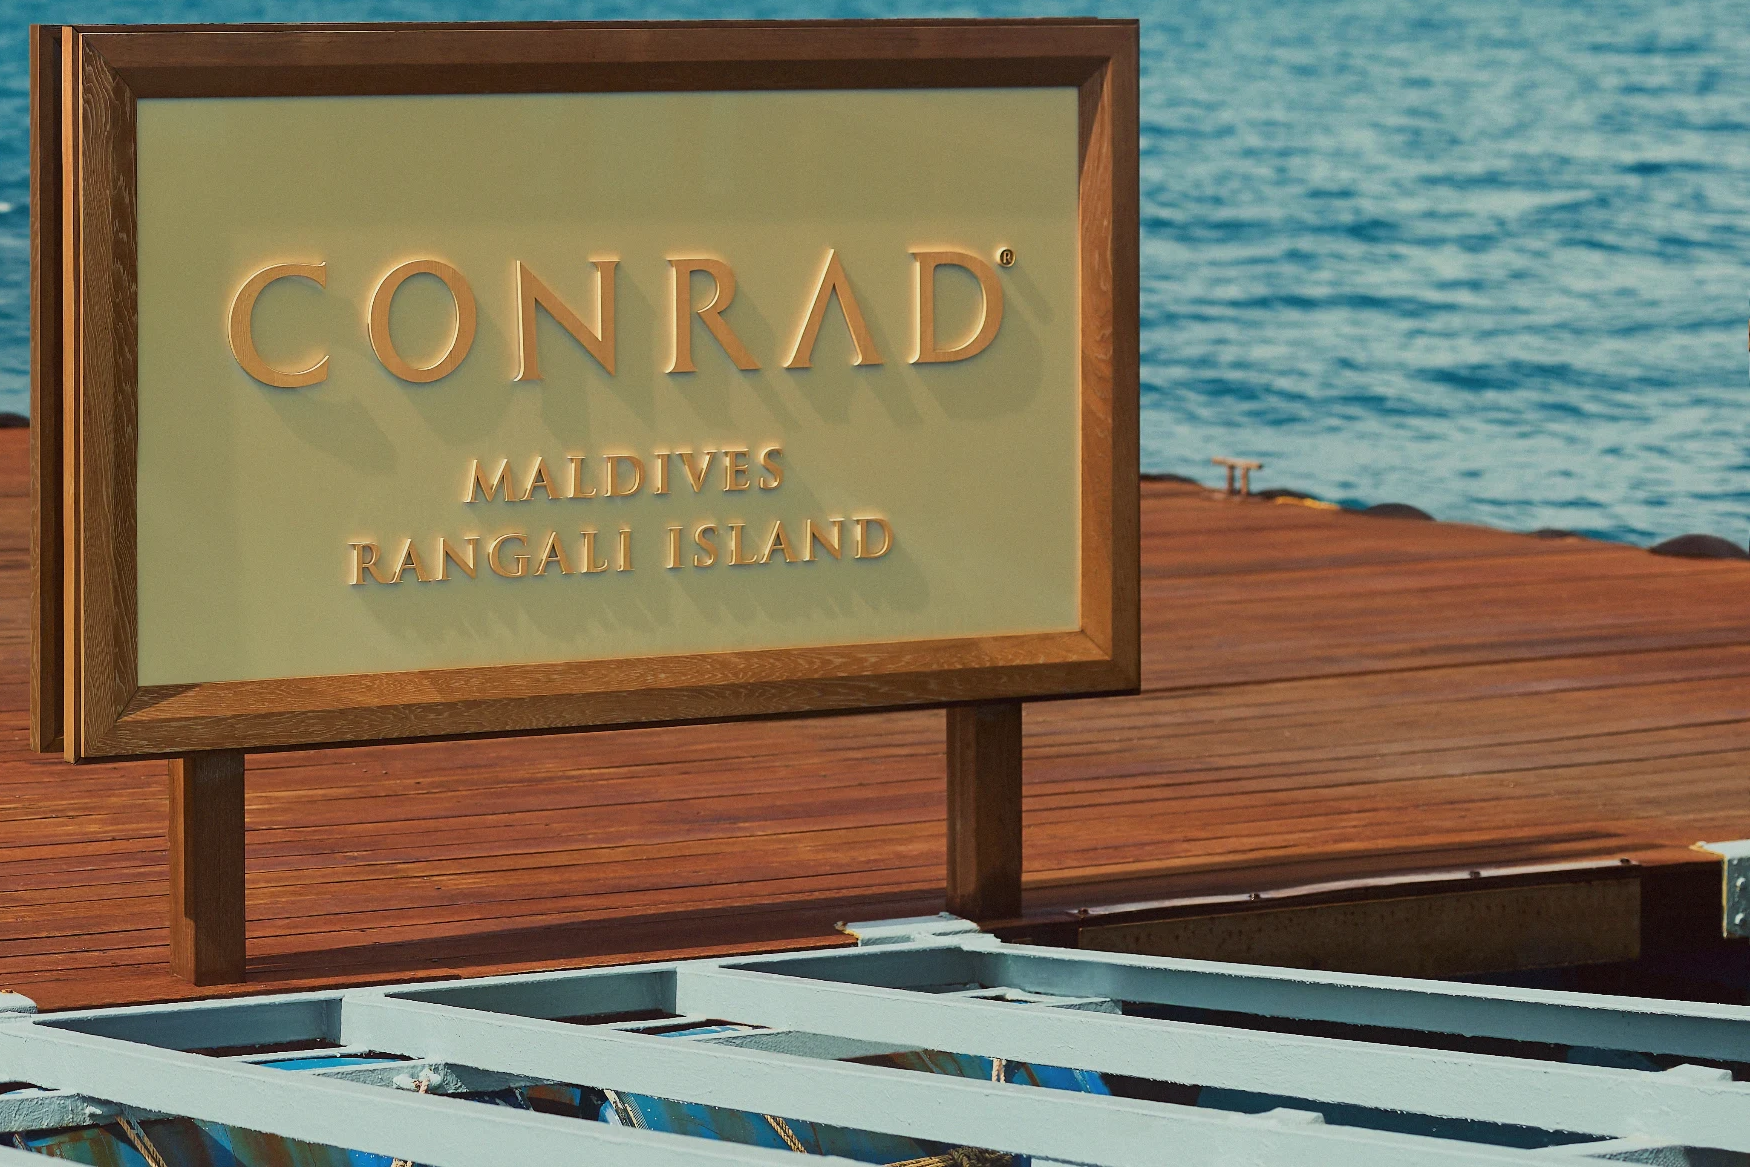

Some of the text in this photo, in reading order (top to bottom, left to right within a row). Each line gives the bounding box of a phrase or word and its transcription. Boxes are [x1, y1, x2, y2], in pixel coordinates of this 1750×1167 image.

[461, 446, 785, 504] MALDIVES
[347, 517, 895, 586] RANGALI ISLAND
